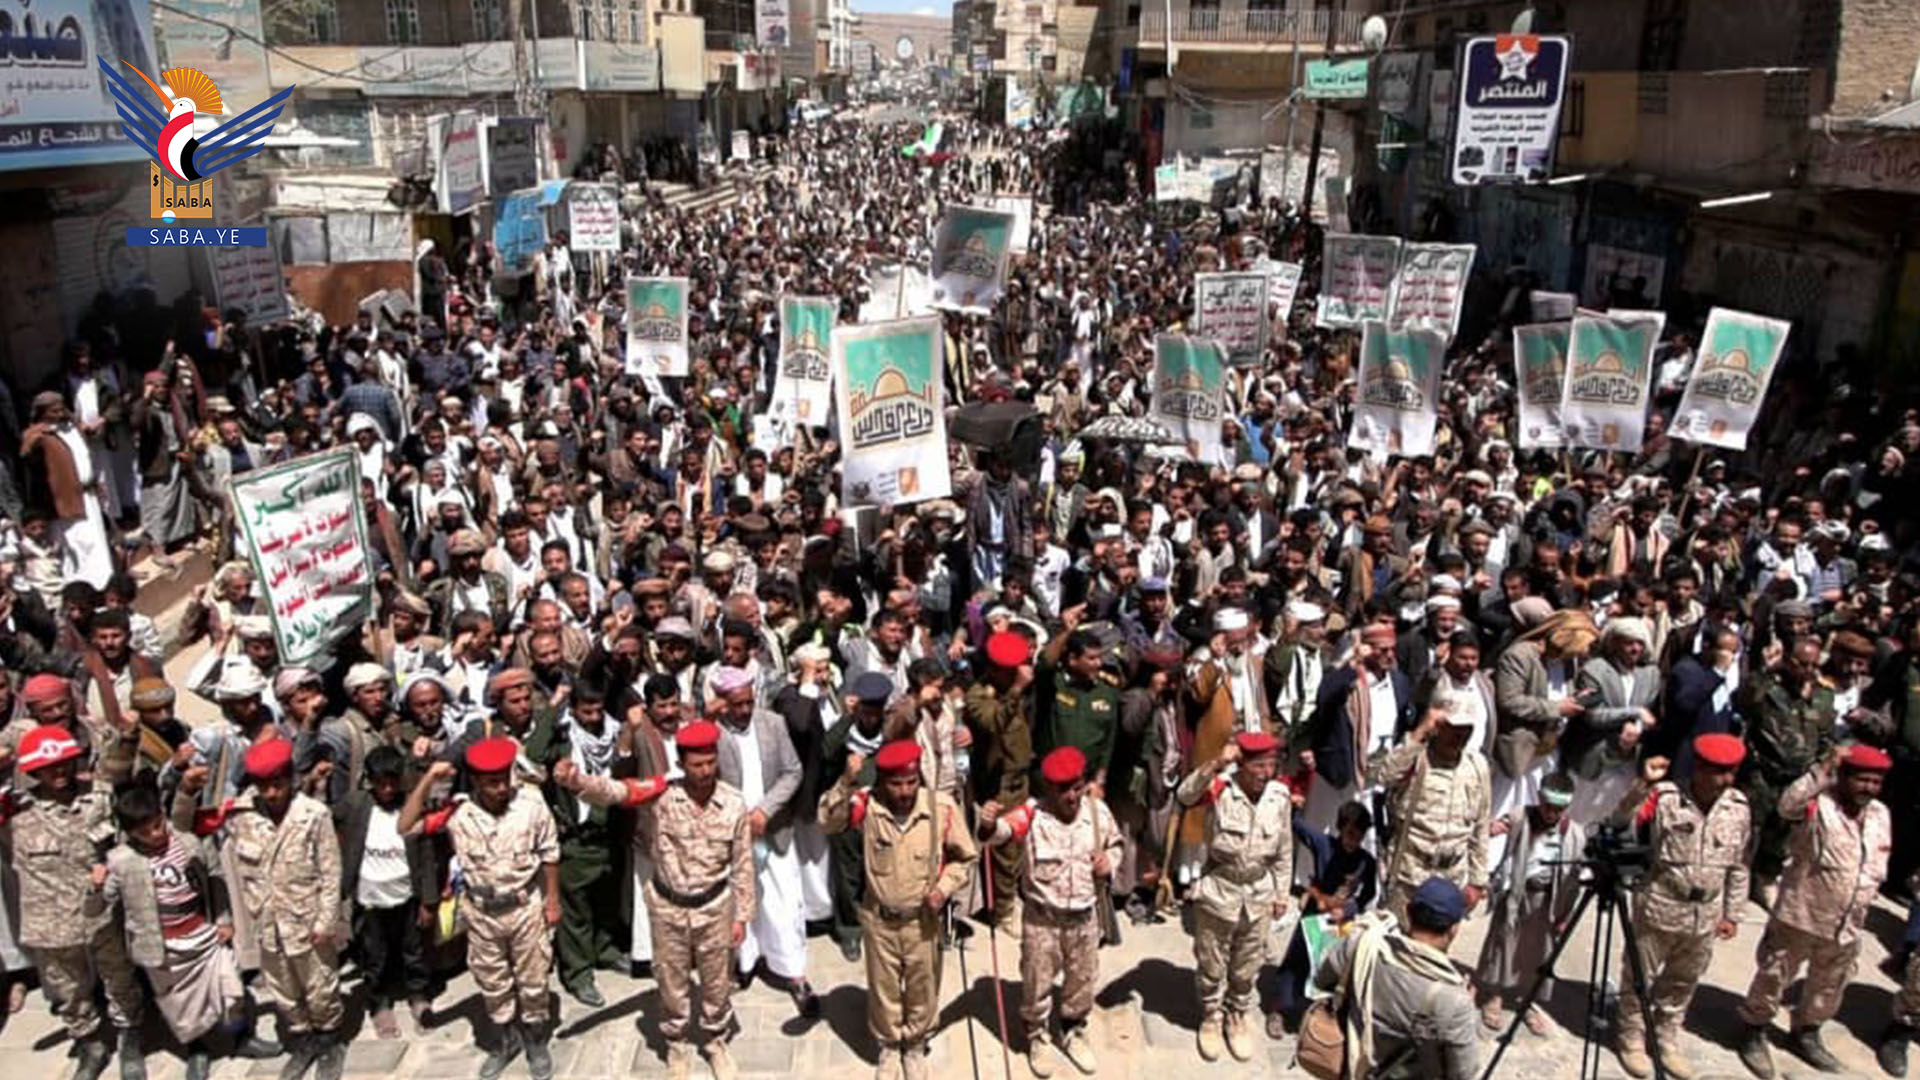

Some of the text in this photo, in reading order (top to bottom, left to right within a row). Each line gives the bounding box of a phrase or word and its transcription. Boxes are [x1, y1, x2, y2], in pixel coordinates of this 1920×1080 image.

[1478, 81, 1548, 102] المنتصر
[0, 129, 33, 146] للم
[39, 126, 102, 146] الشجاع
[314, 466, 351, 497] الله
